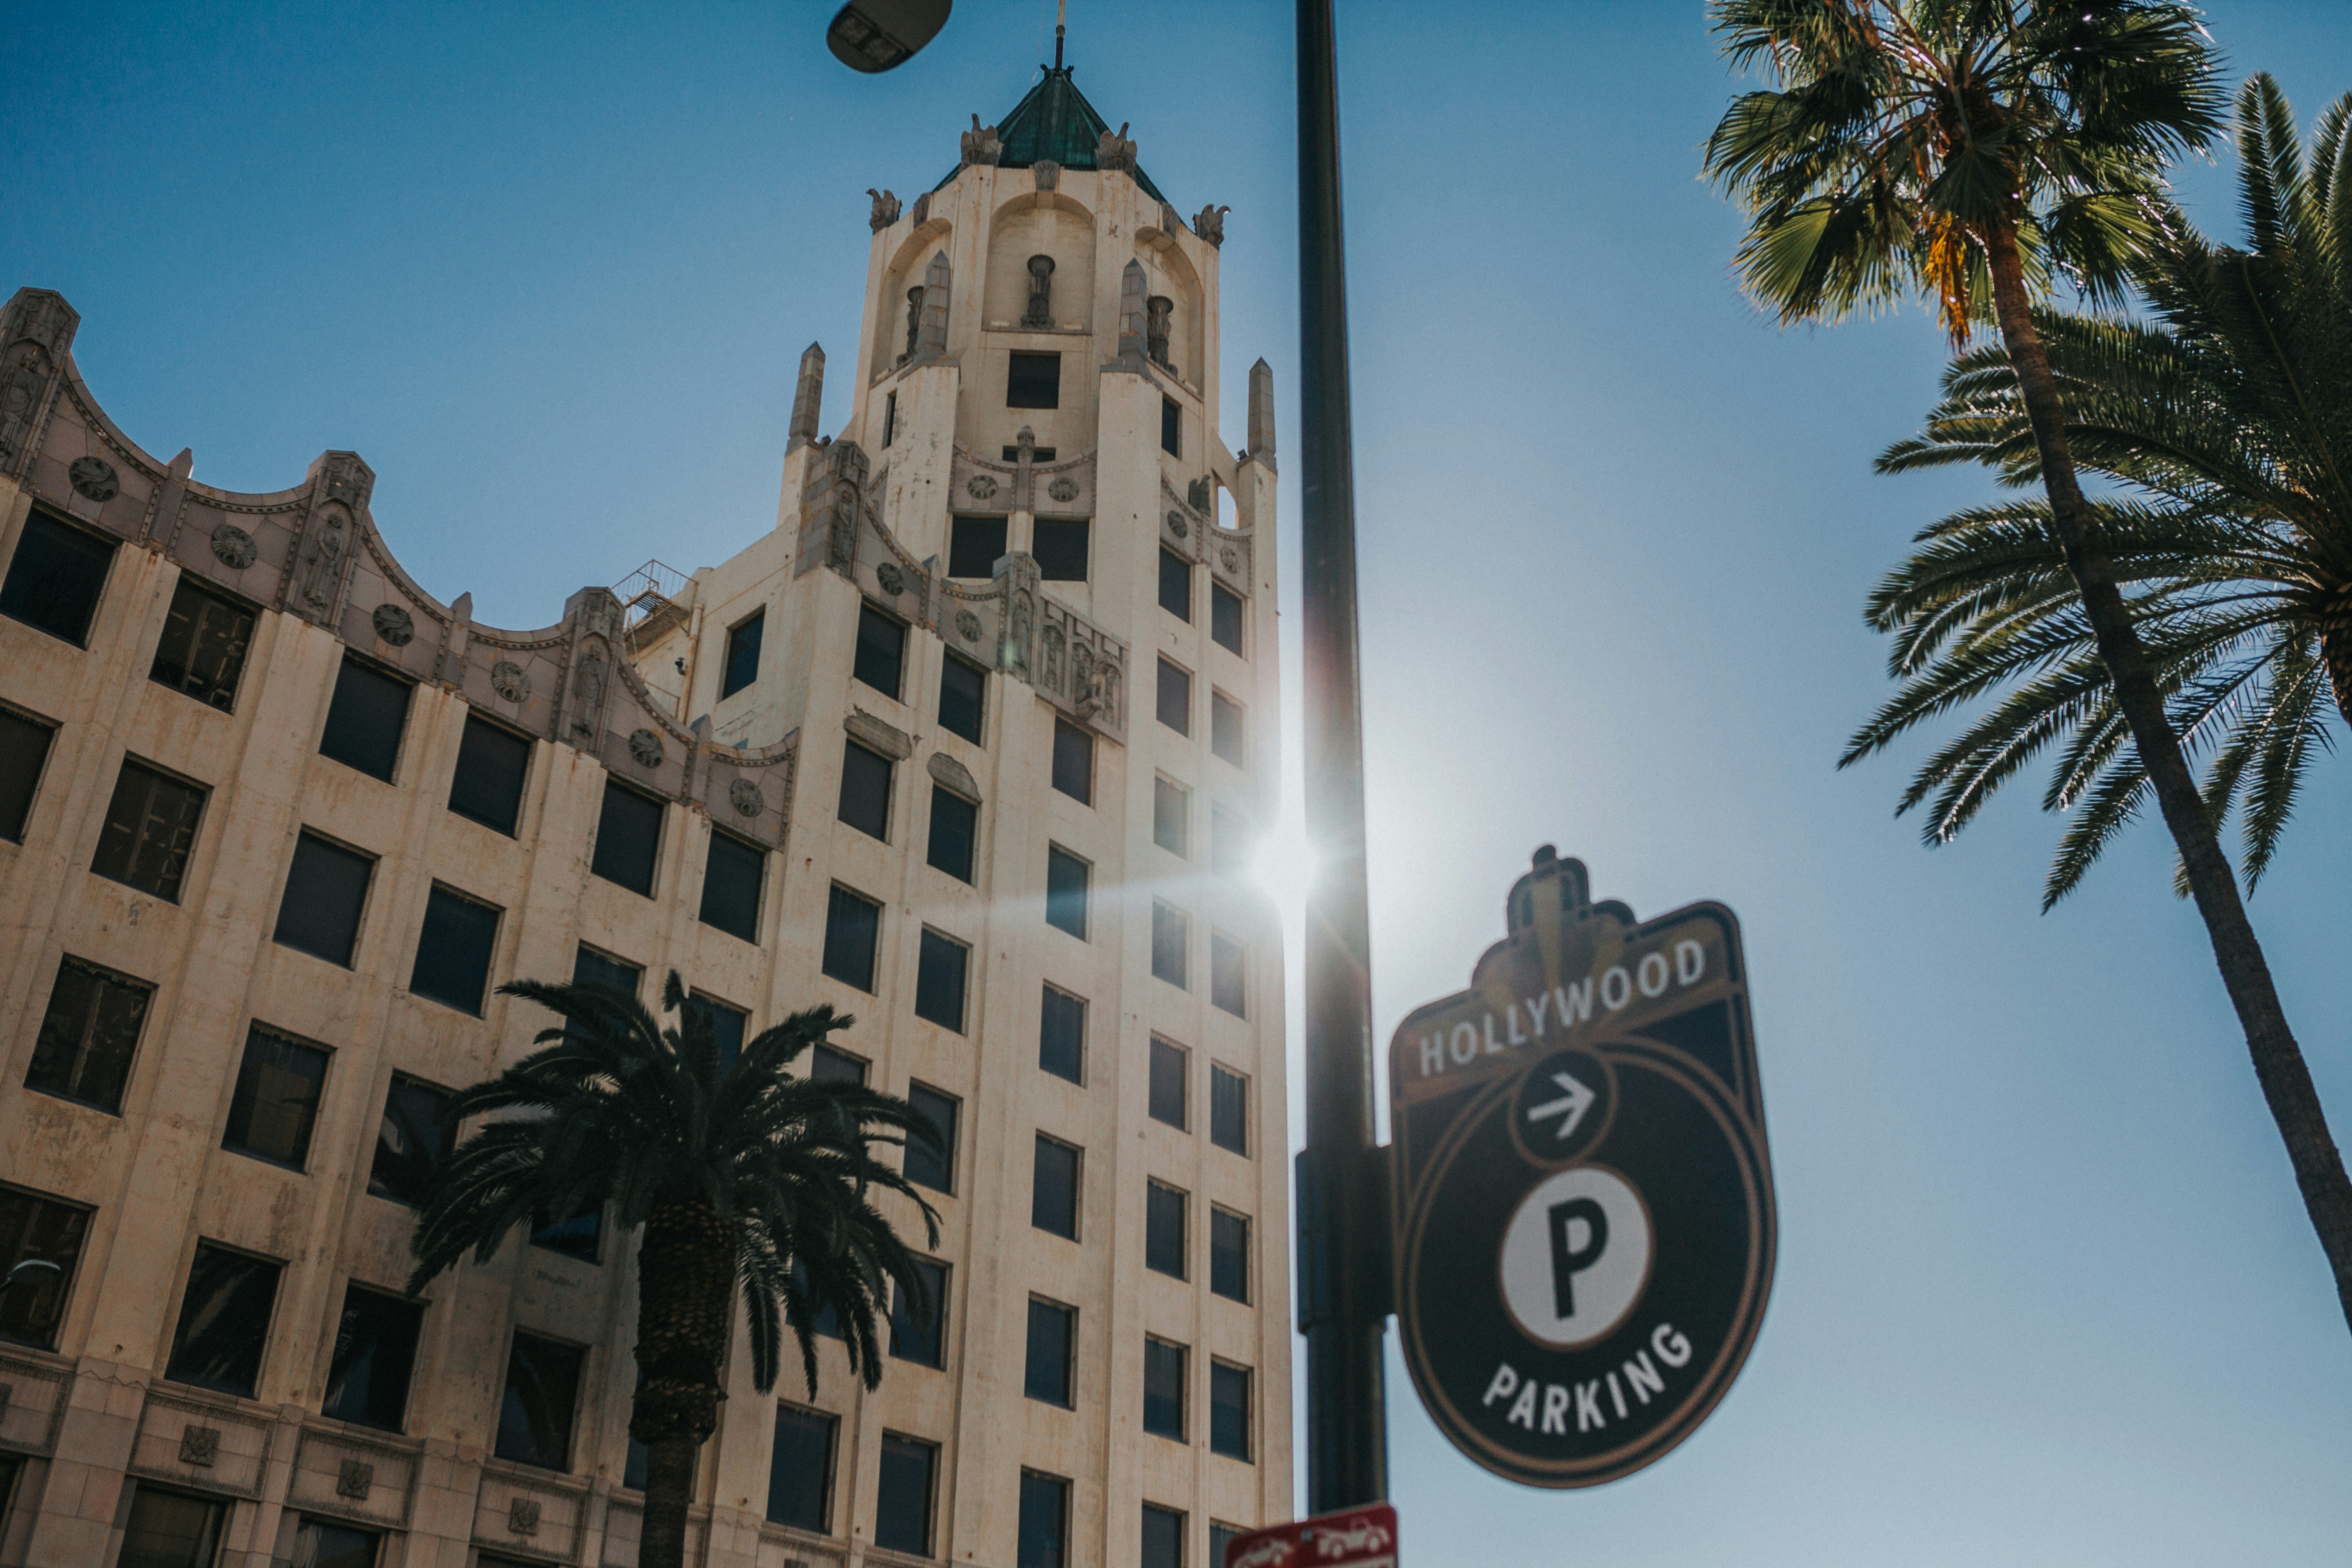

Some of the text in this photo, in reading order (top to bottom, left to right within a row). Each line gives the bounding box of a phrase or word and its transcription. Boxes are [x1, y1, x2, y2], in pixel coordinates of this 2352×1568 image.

[1419, 939, 1705, 1075] HOLLYWOOD
[1548, 1197, 1609, 1320] P
[1483, 1322, 1692, 1434] PARKING
